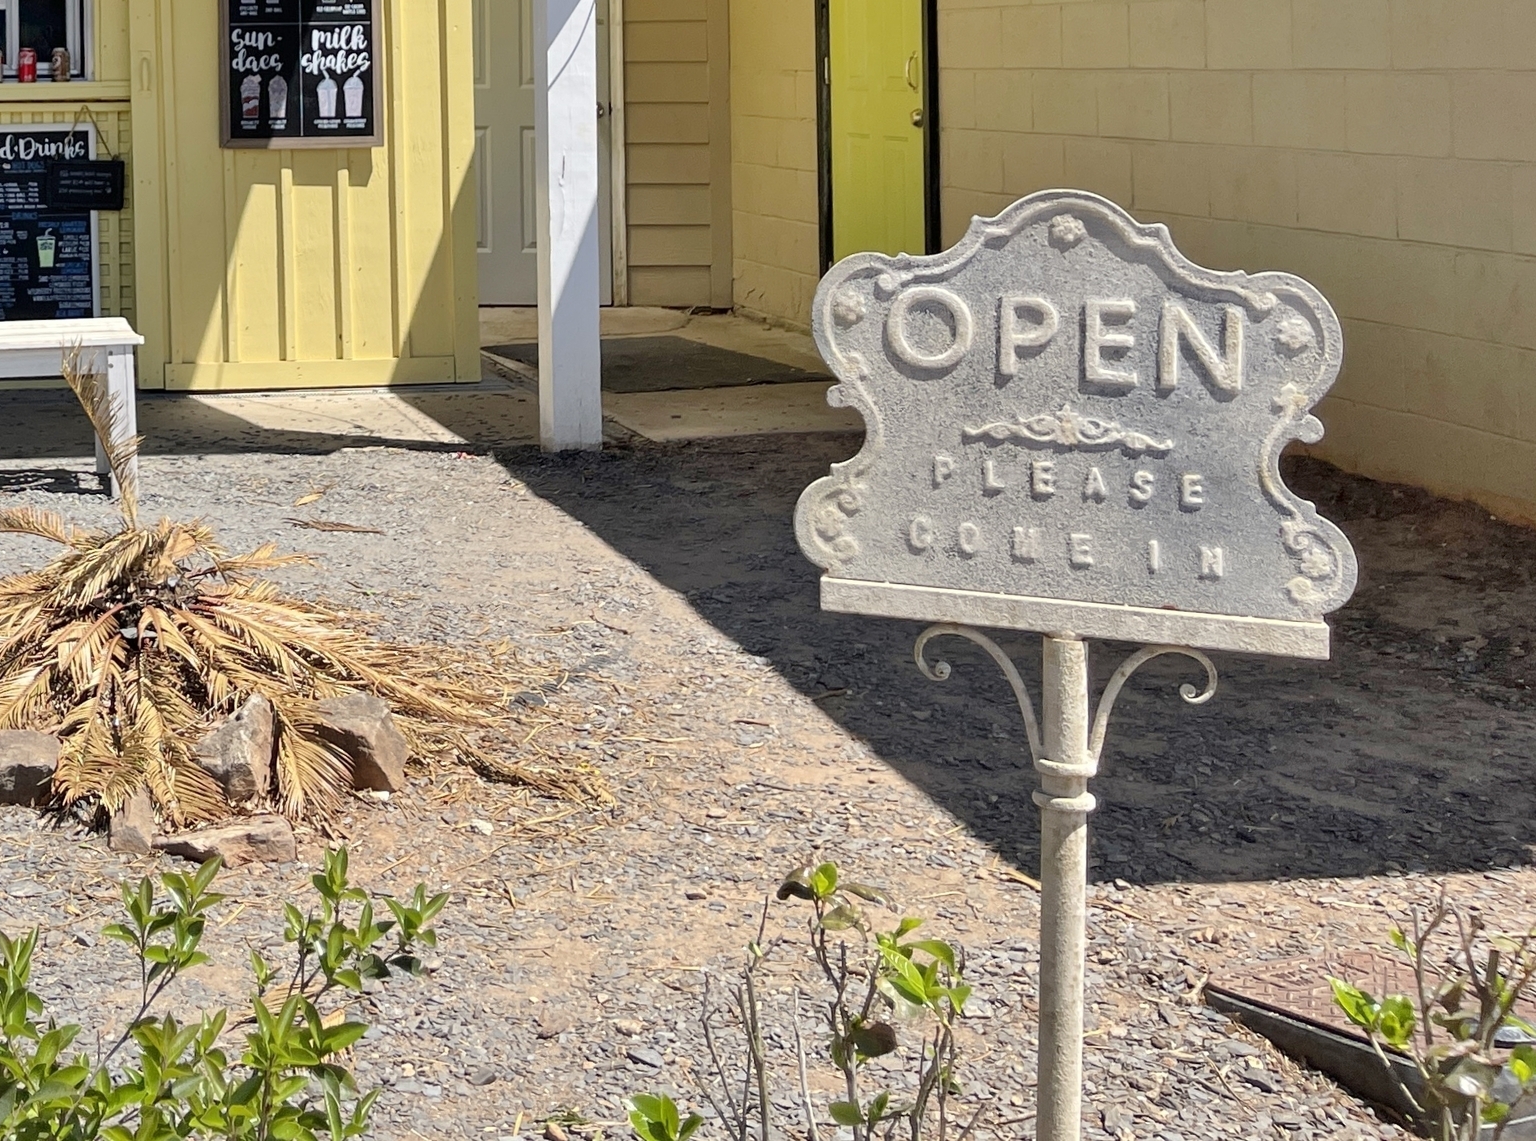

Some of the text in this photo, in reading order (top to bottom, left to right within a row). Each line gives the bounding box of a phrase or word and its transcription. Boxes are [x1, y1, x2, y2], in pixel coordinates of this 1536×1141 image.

[311, 24, 368, 51] milk
[232, 48, 284, 72] daes
[300, 49, 371, 75] shakes
[886, 286, 1245, 392] OPEN
[933, 455, 1204, 504] PLEASE
[910, 516, 1223, 577] COME IN
